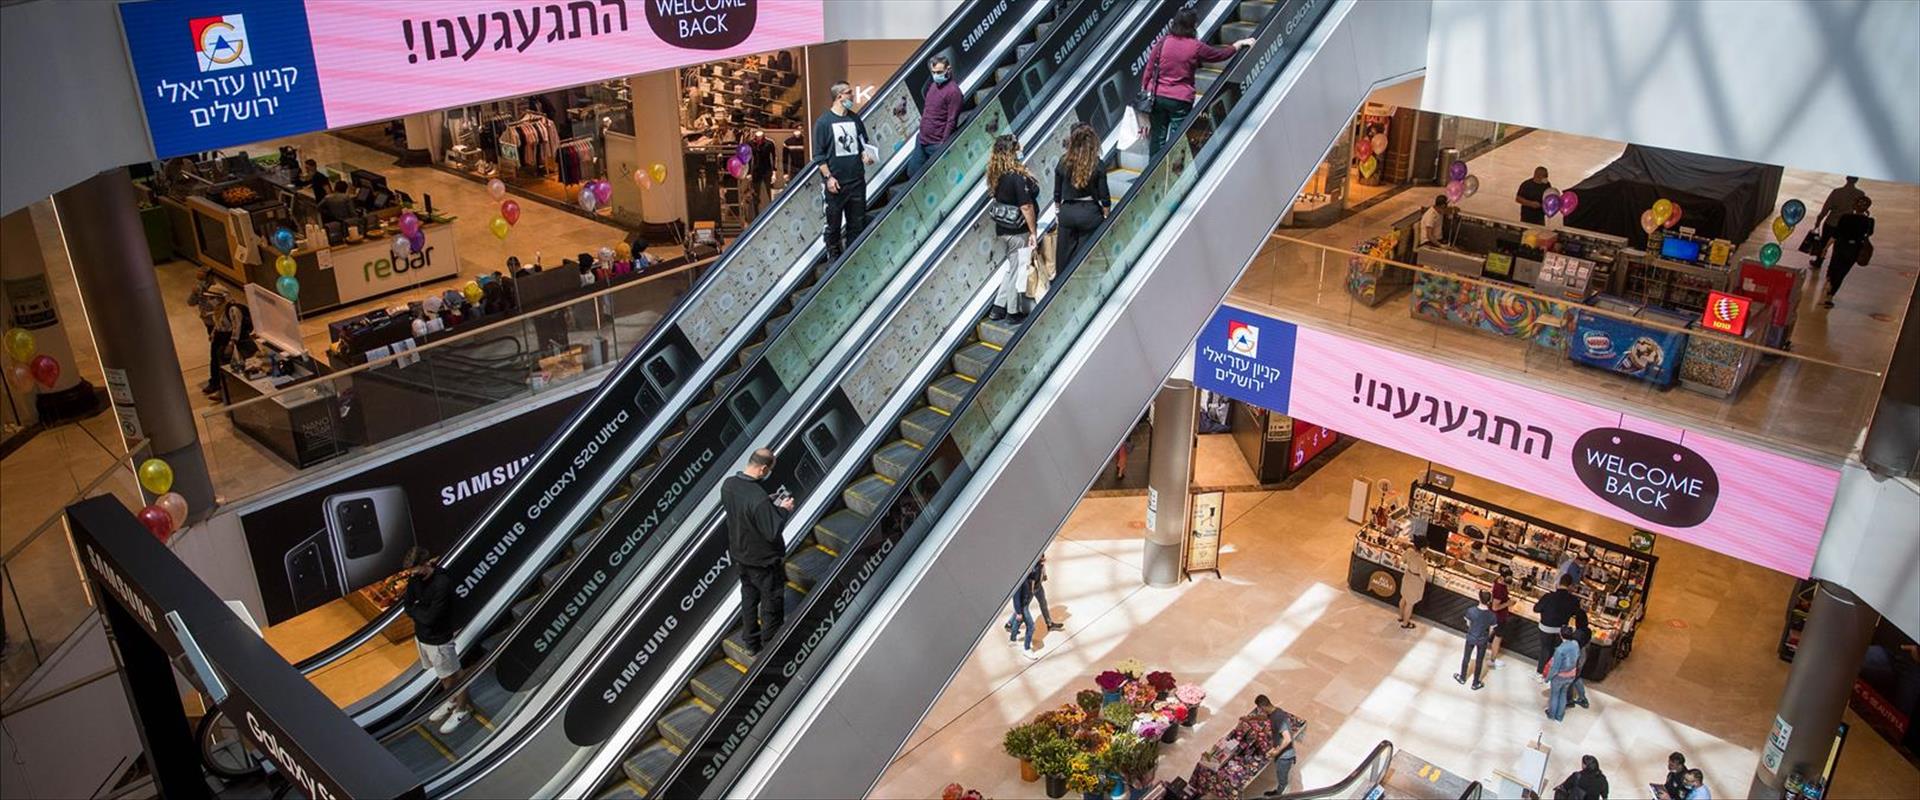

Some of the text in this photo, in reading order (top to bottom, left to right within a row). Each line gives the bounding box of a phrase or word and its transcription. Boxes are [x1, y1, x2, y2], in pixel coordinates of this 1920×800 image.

[402, 0, 629, 65] התגעגענו!
[679, 13, 728, 38] BACK
[962, 1, 1008, 52] SAMSUNG
[1054, 10, 1100, 65] SAMSUNG
[157, 66, 298, 104] קניון עזריאלי
[1240, 34, 1284, 95] SAMSUNG
[190, 96, 279, 128] ירושלים
[363, 246, 434, 282] rebar
[1203, 345, 1281, 384] קניון עזריאלי
[1215, 367, 1265, 392] ירושלים
[1353, 372, 1554, 461] התגעגענו!
[1587, 448, 1704, 498] WELCOME
[1605, 476, 1670, 511] BACK
[455, 409, 630, 598] SAMSUNG Galaxy S20 Ultra
[534, 448, 714, 653] SAMSUNG Galaxy S20 Ultra
[86, 543, 158, 633] SAMSUNG
[603, 550, 732, 704] SAMSUNG Galaxy
[702, 538, 894, 780] SAMSUNG Galaxy S20 Ultra
[246, 711, 317, 800] Galaxy
